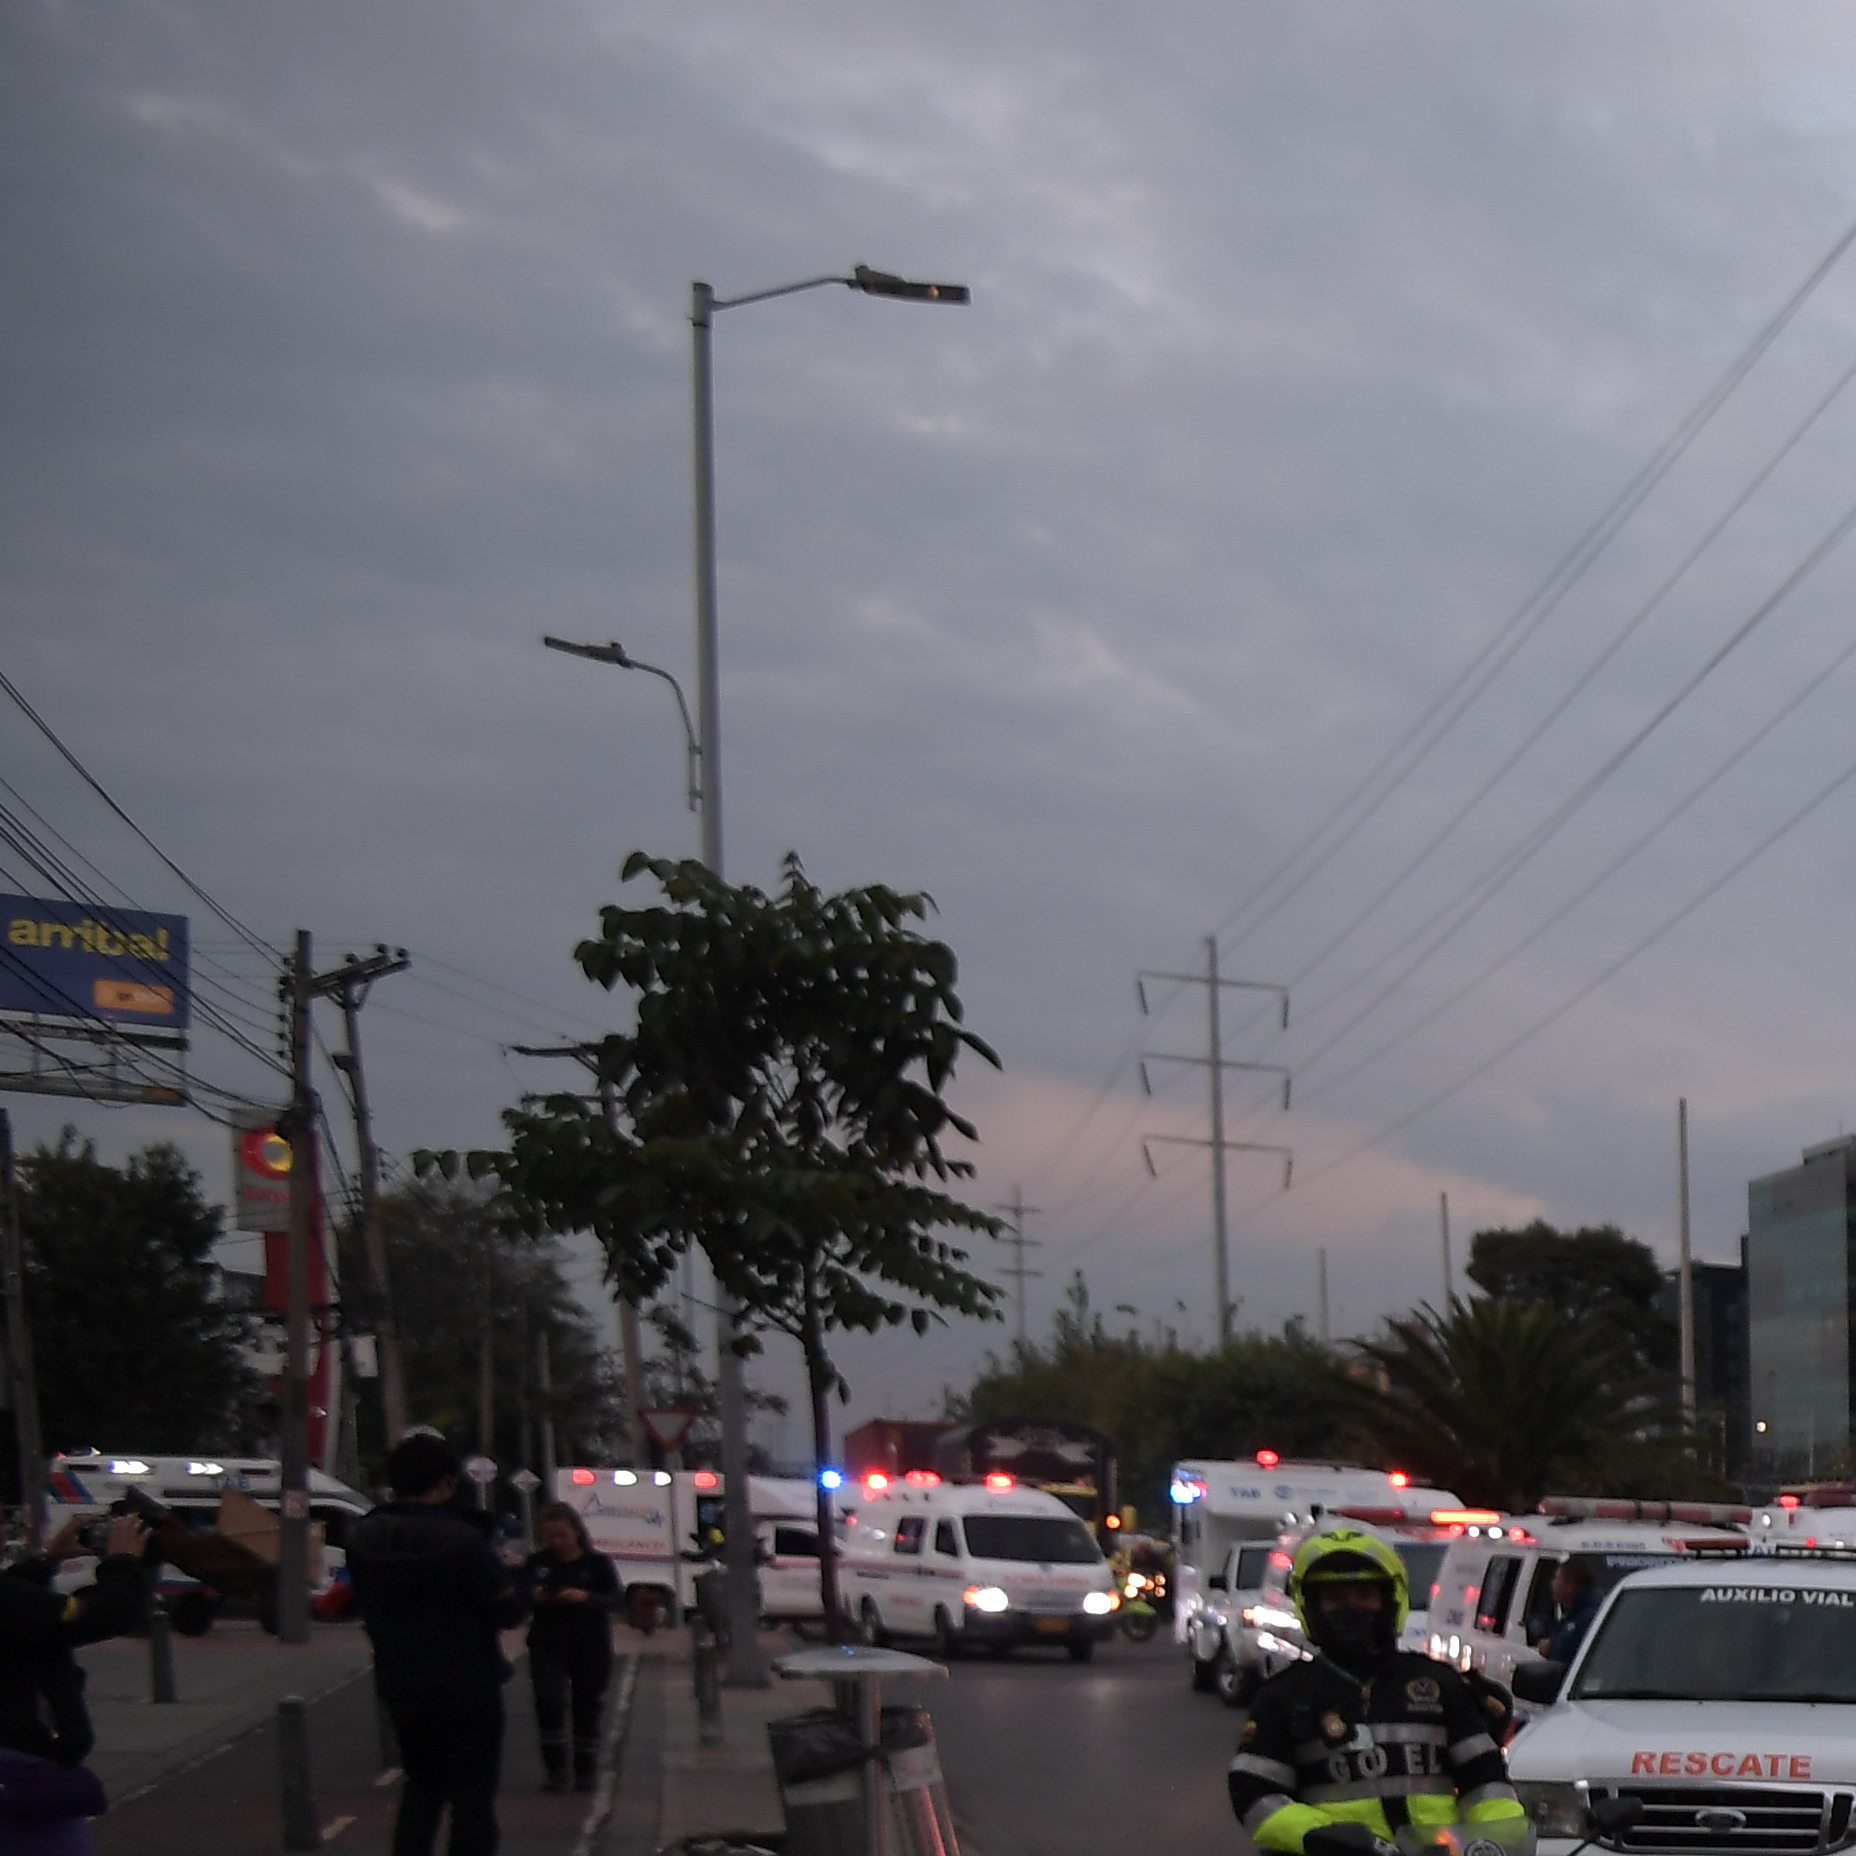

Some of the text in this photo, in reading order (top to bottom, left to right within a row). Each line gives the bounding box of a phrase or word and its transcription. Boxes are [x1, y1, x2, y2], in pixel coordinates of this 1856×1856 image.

[8, 918, 170, 961] arriba!
[1700, 1587, 1854, 1607] AUXILIO VIAL
[1631, 1752, 1812, 1779] RESCATE
